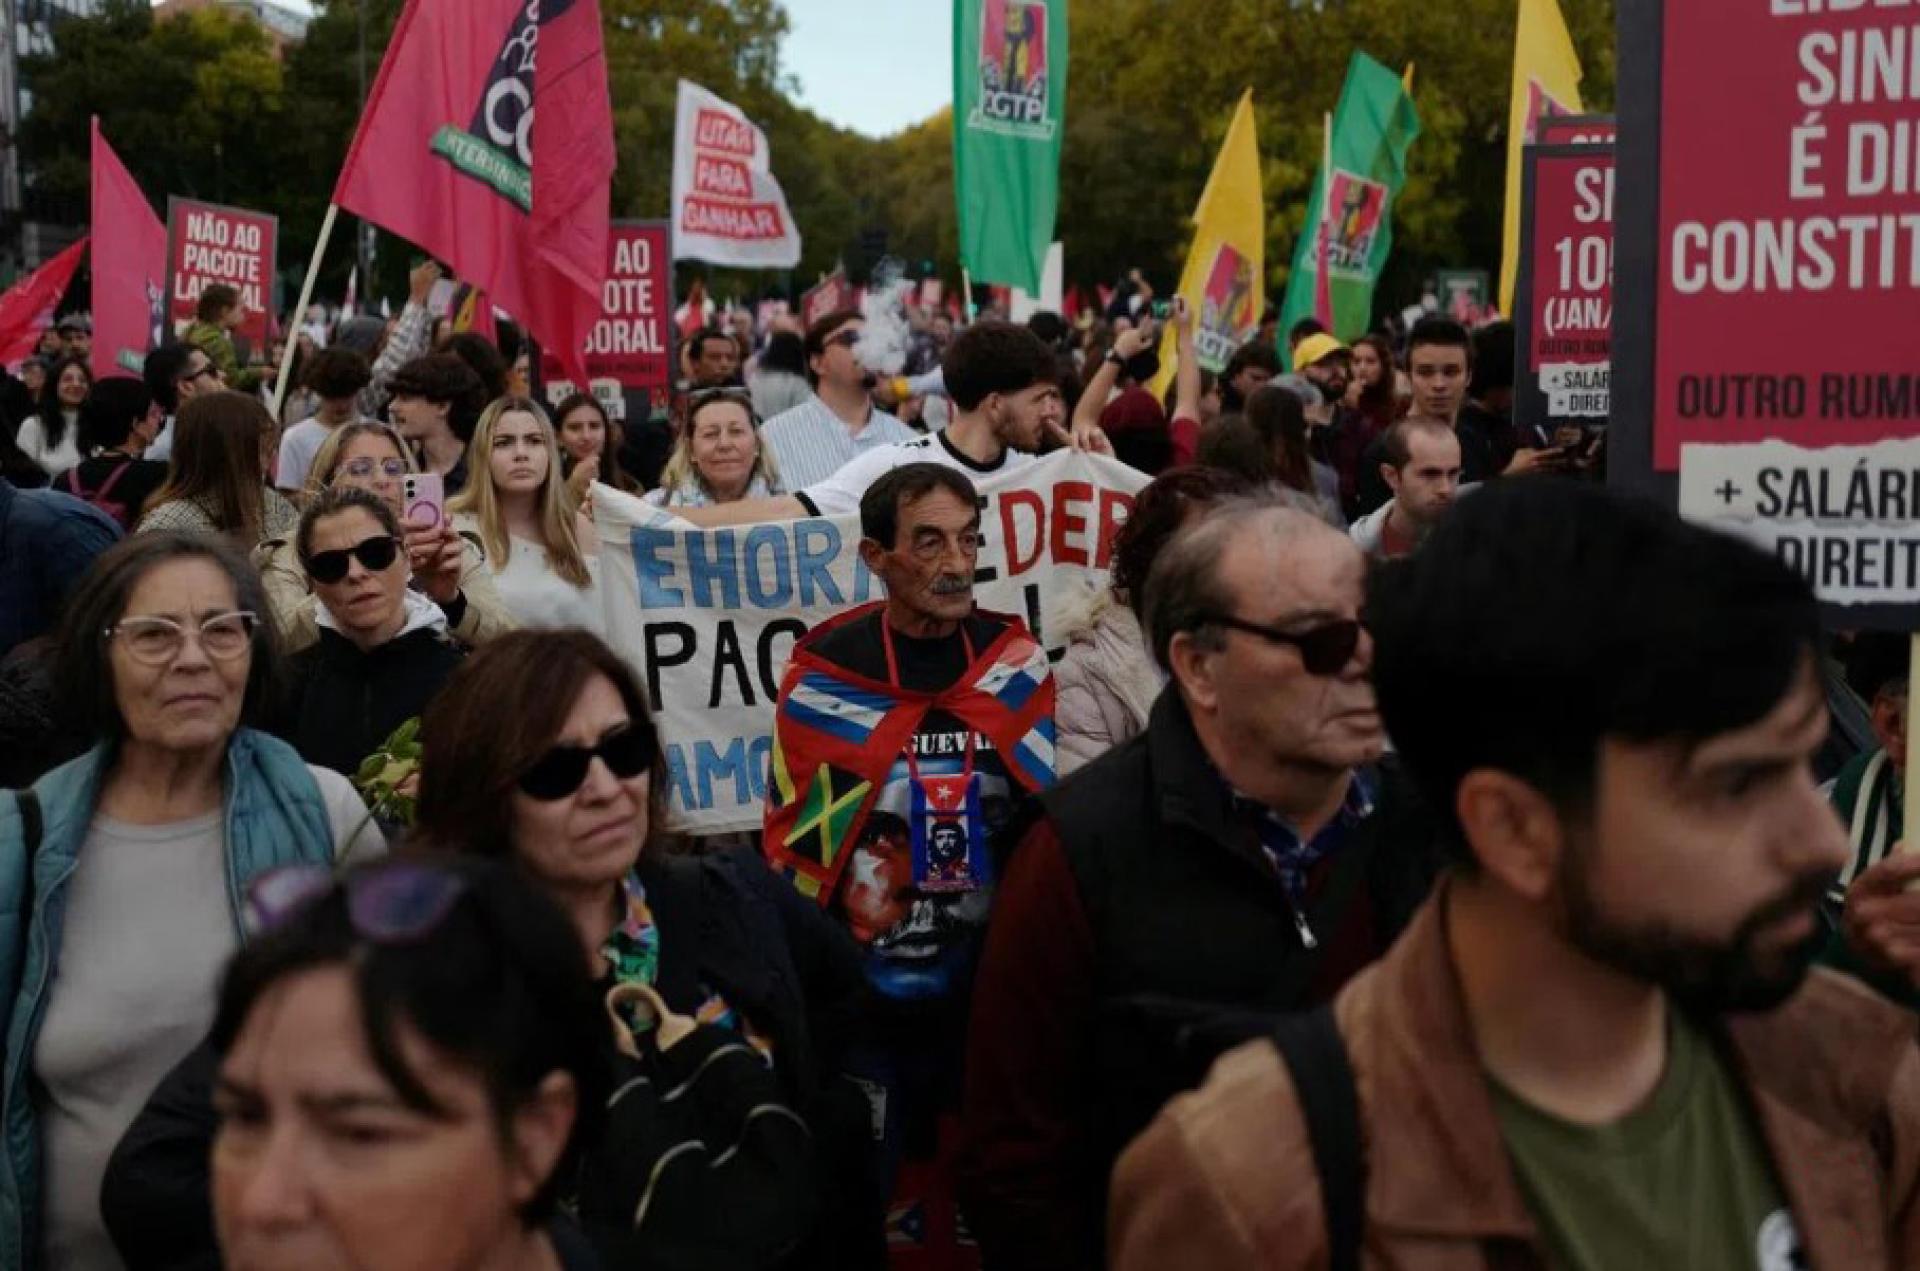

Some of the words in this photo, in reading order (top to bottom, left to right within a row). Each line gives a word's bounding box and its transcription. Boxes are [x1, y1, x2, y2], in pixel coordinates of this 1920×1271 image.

[1797, 25, 1920, 106] SIN
[1790, 110, 1828, 200] É
[1846, 119, 1920, 197] DI
[187, 211, 229, 246] NÃO
[233, 223, 261, 251] AO
[183, 242, 262, 283] PACOTE
[614, 239, 650, 274] AO
[1553, 235, 1614, 292] 10
[1677, 374, 1806, 420] OUTRO
[1819, 372, 1920, 420] RUM
[1714, 480, 1742, 504] +
